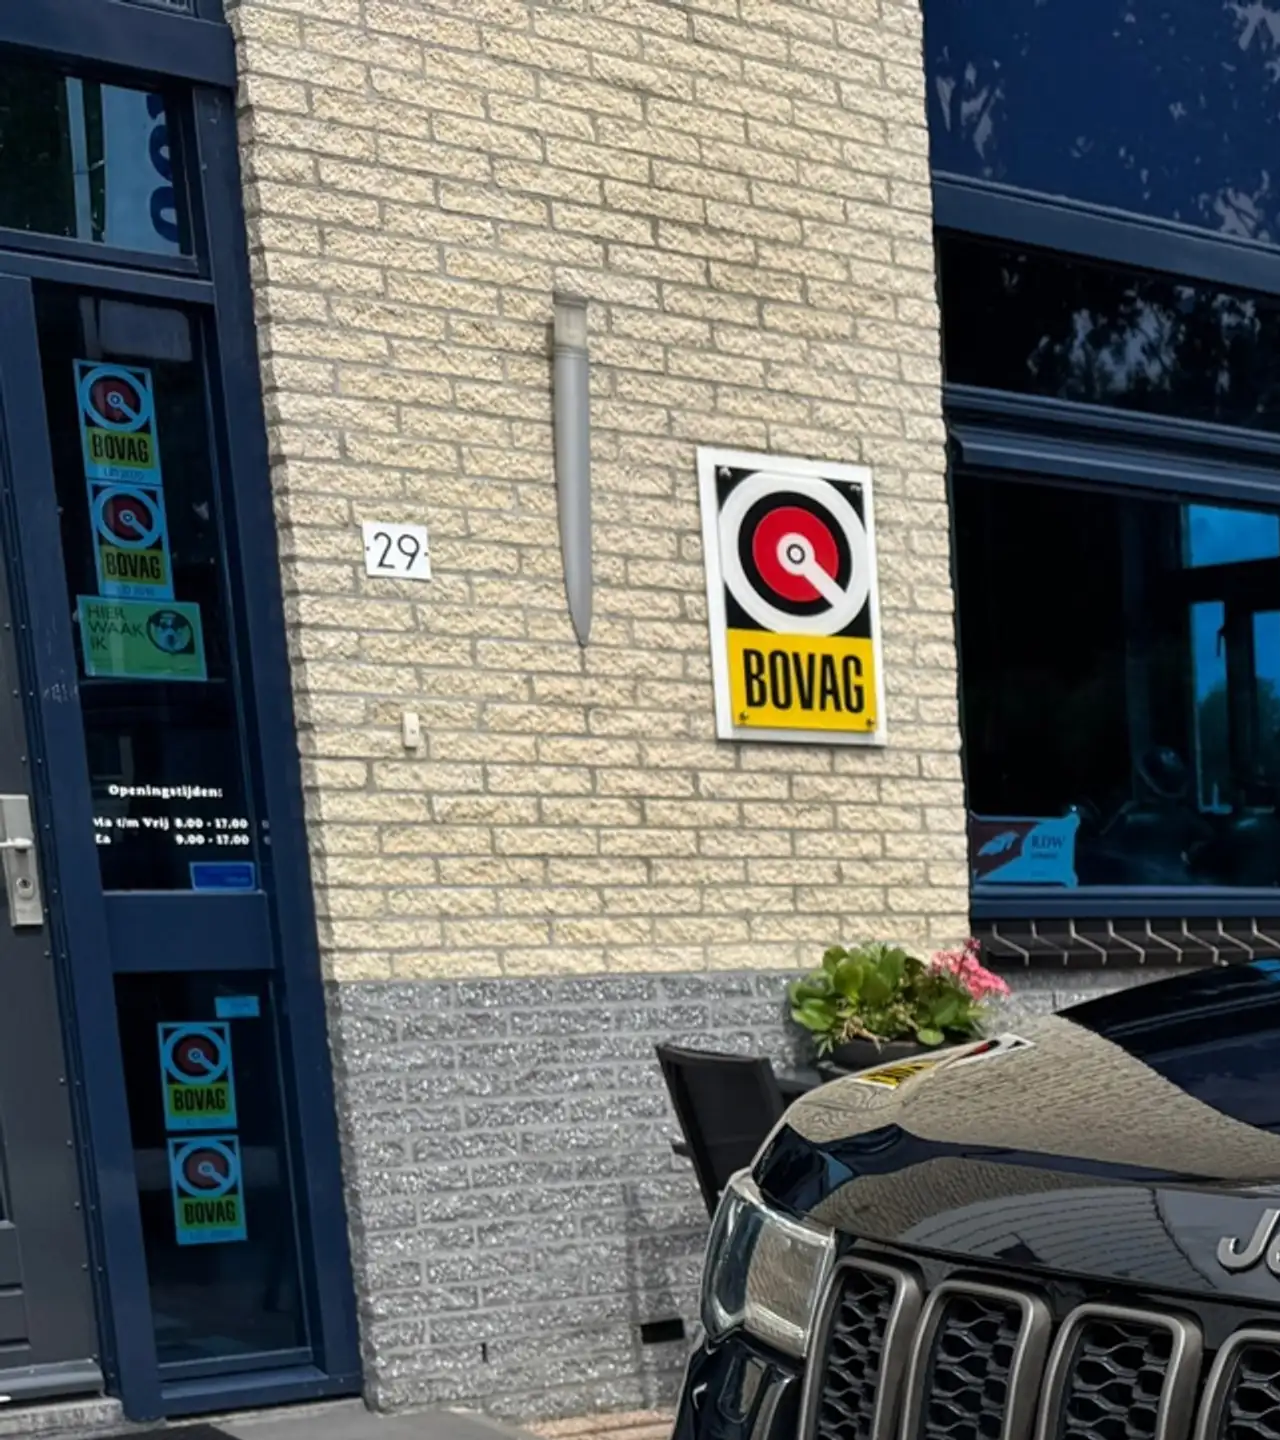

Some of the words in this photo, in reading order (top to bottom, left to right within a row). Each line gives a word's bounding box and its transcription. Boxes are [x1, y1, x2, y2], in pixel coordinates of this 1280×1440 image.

[92, 433, 150, 463] BOVAG
[373, 531, 420, 571] 29
[105, 551, 162, 579] BOVAG
[88, 620, 145, 639] WAAK
[742, 648, 864, 713] BOVAG
[108, 784, 223, 799] Openingstijden:
[173, 1087, 226, 1112] BOVAG
[184, 1200, 236, 1225] BOVAG
